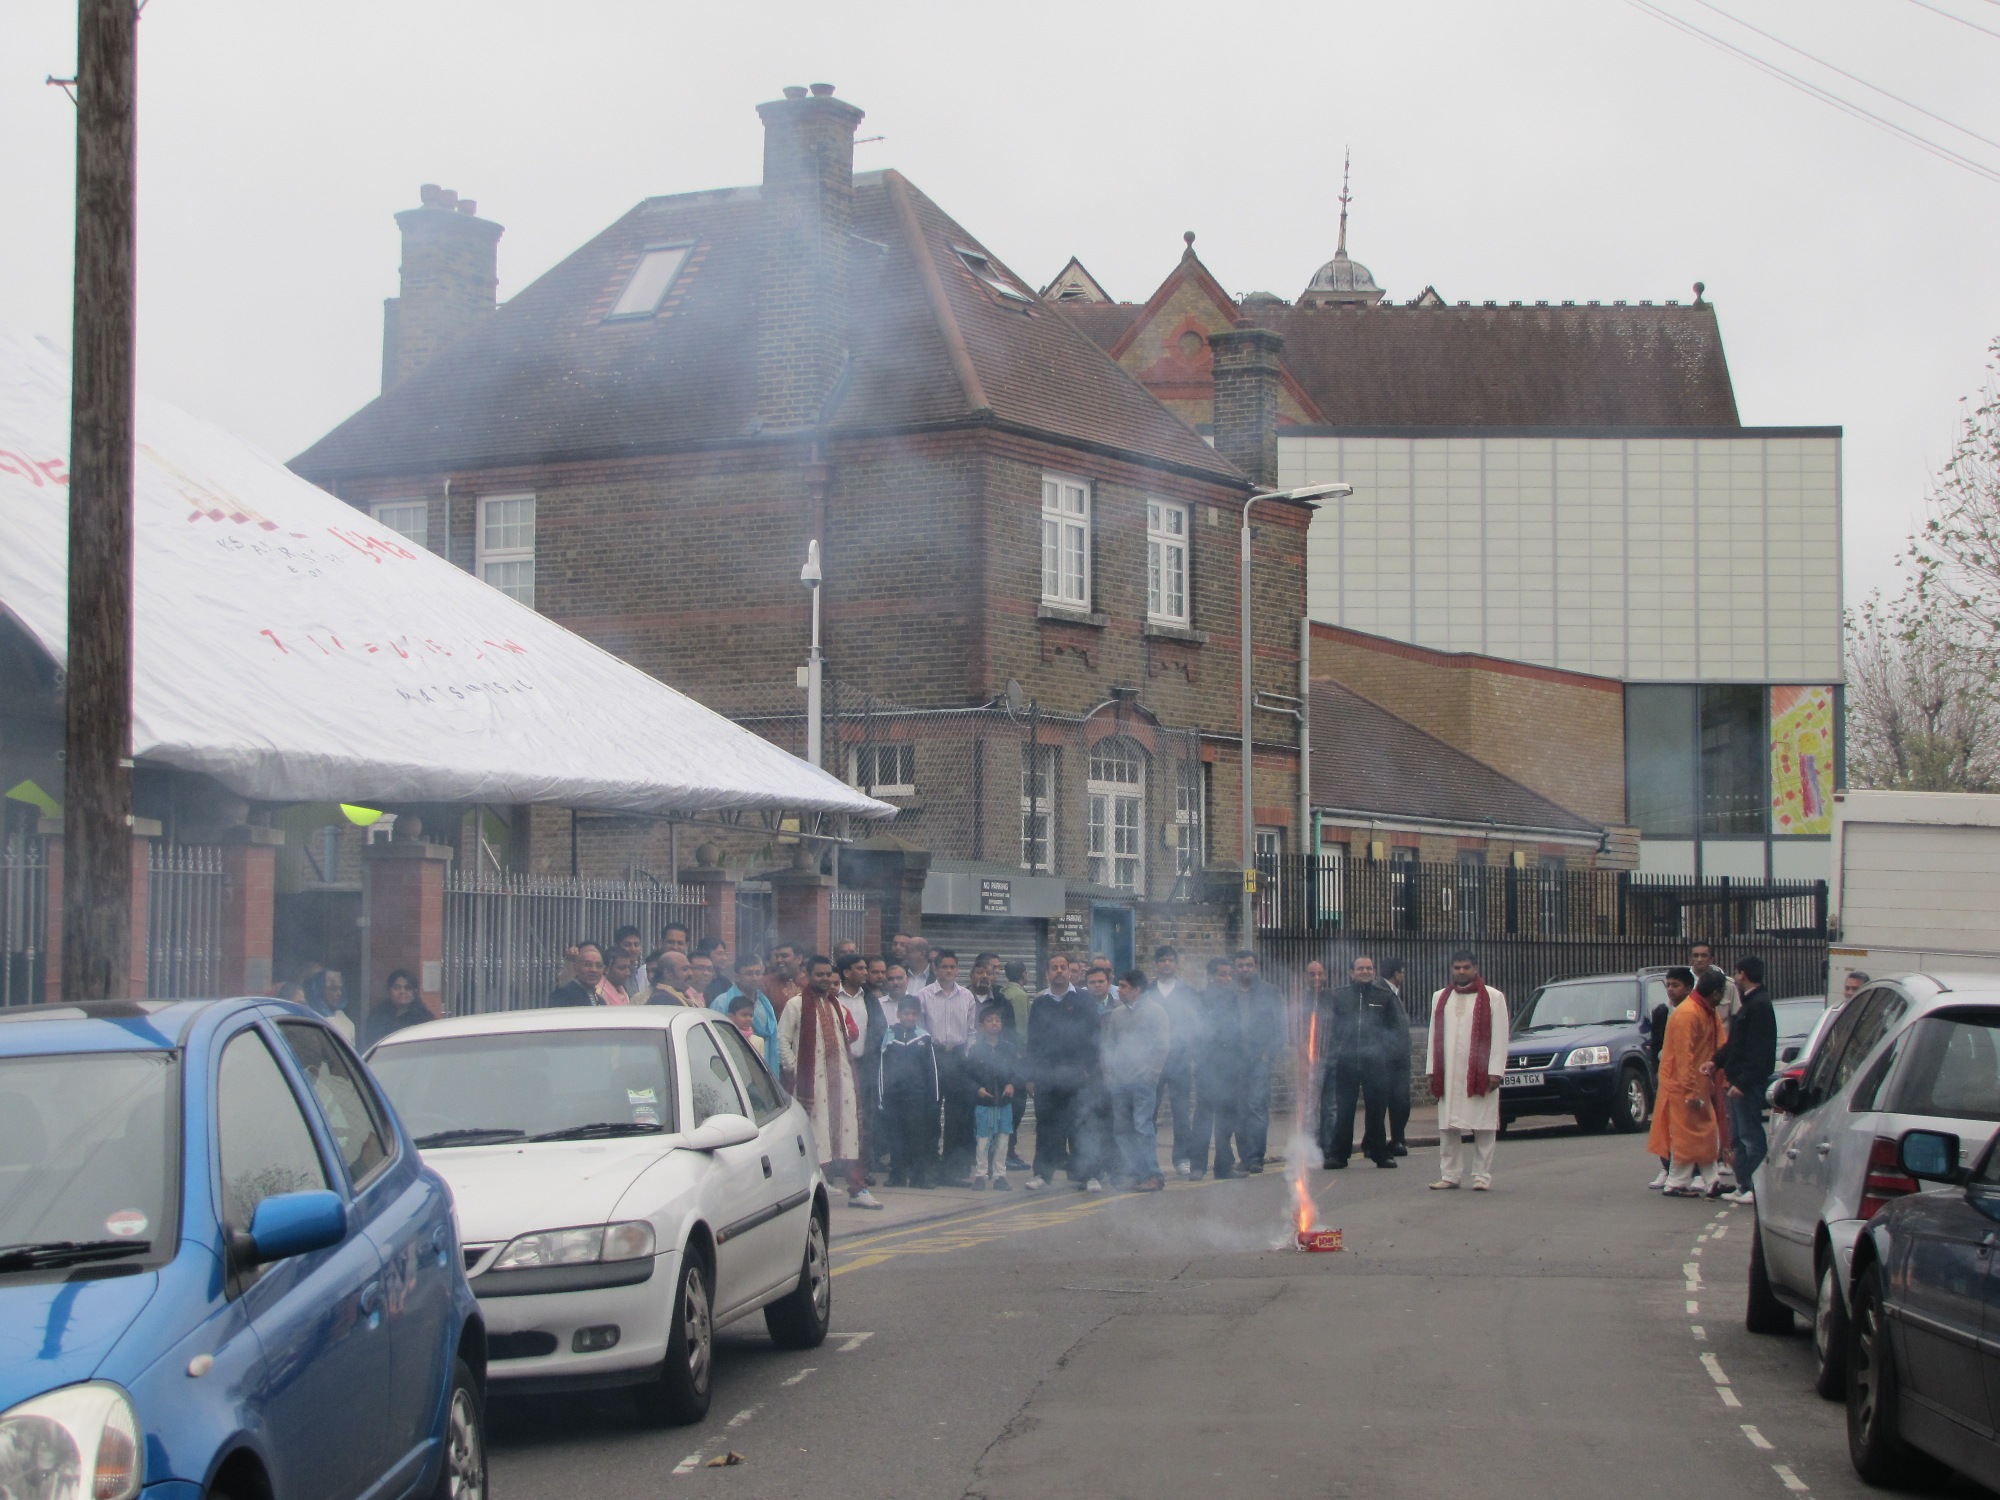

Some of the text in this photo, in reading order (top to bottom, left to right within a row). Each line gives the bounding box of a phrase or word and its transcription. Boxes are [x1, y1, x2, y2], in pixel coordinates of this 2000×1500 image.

[991, 882, 1009, 891] PARKING
[1066, 914, 1082, 922] PARKING
[1523, 1074, 1540, 1084] TGX
